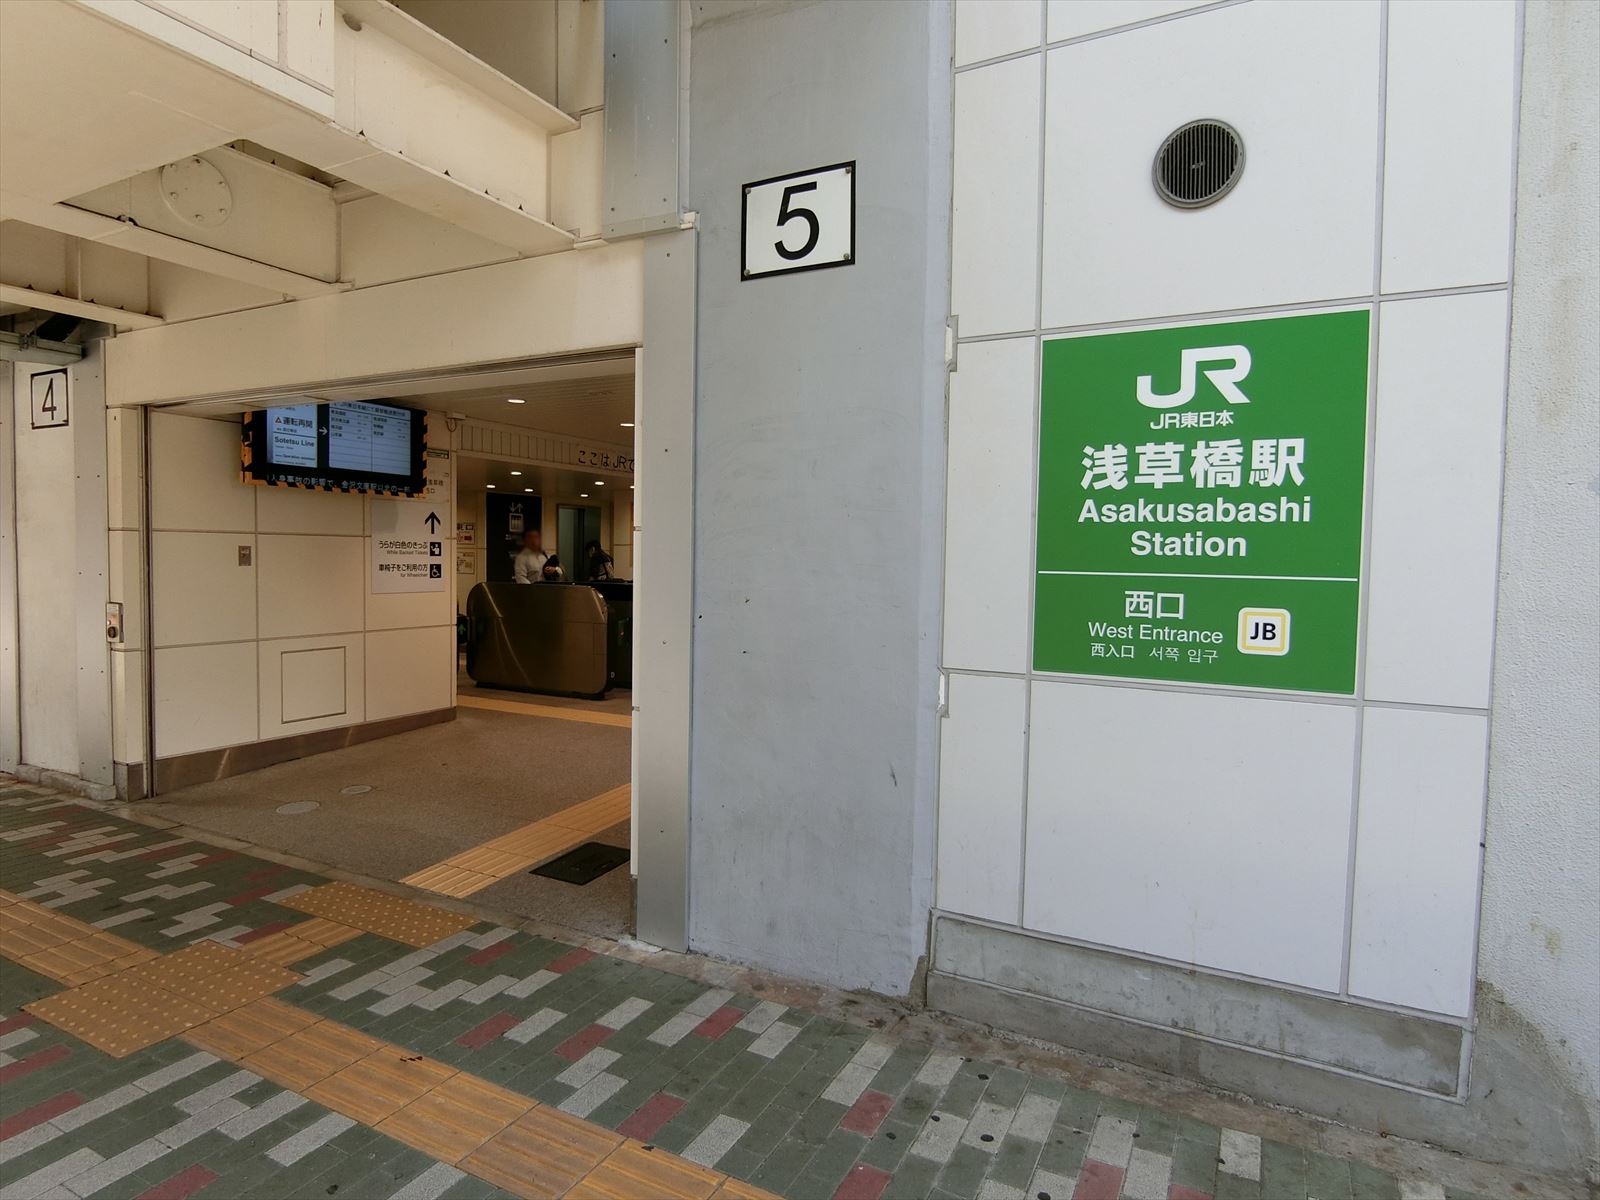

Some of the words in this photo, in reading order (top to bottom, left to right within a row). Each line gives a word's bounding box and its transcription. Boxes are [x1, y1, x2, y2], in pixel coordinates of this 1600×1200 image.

[775, 181, 820, 260] 5
[1137, 345, 1251, 408] JR
[42, 378, 57, 420] 4
[1150, 410, 1234, 429] JR東日本
[274, 436, 299, 446] Sotetsu
[301, 439, 314, 447] Line
[1081, 438, 1304, 490] 浅草橋駅
[1078, 496, 1311, 523] Asakusabashi
[379, 540, 428, 549] うらが白色のきっぷ
[1131, 530, 1247, 557] Station
[1124, 590, 1184, 619] 西口
[1088, 622, 1133, 639] West
[1139, 624, 1224, 644] Entrance
[1250, 622, 1277, 641] JB
[1091, 643, 1135, 659] 西入口
[1149, 647, 1180, 662] 서쪽
[1188, 648, 1219, 664] 입구
